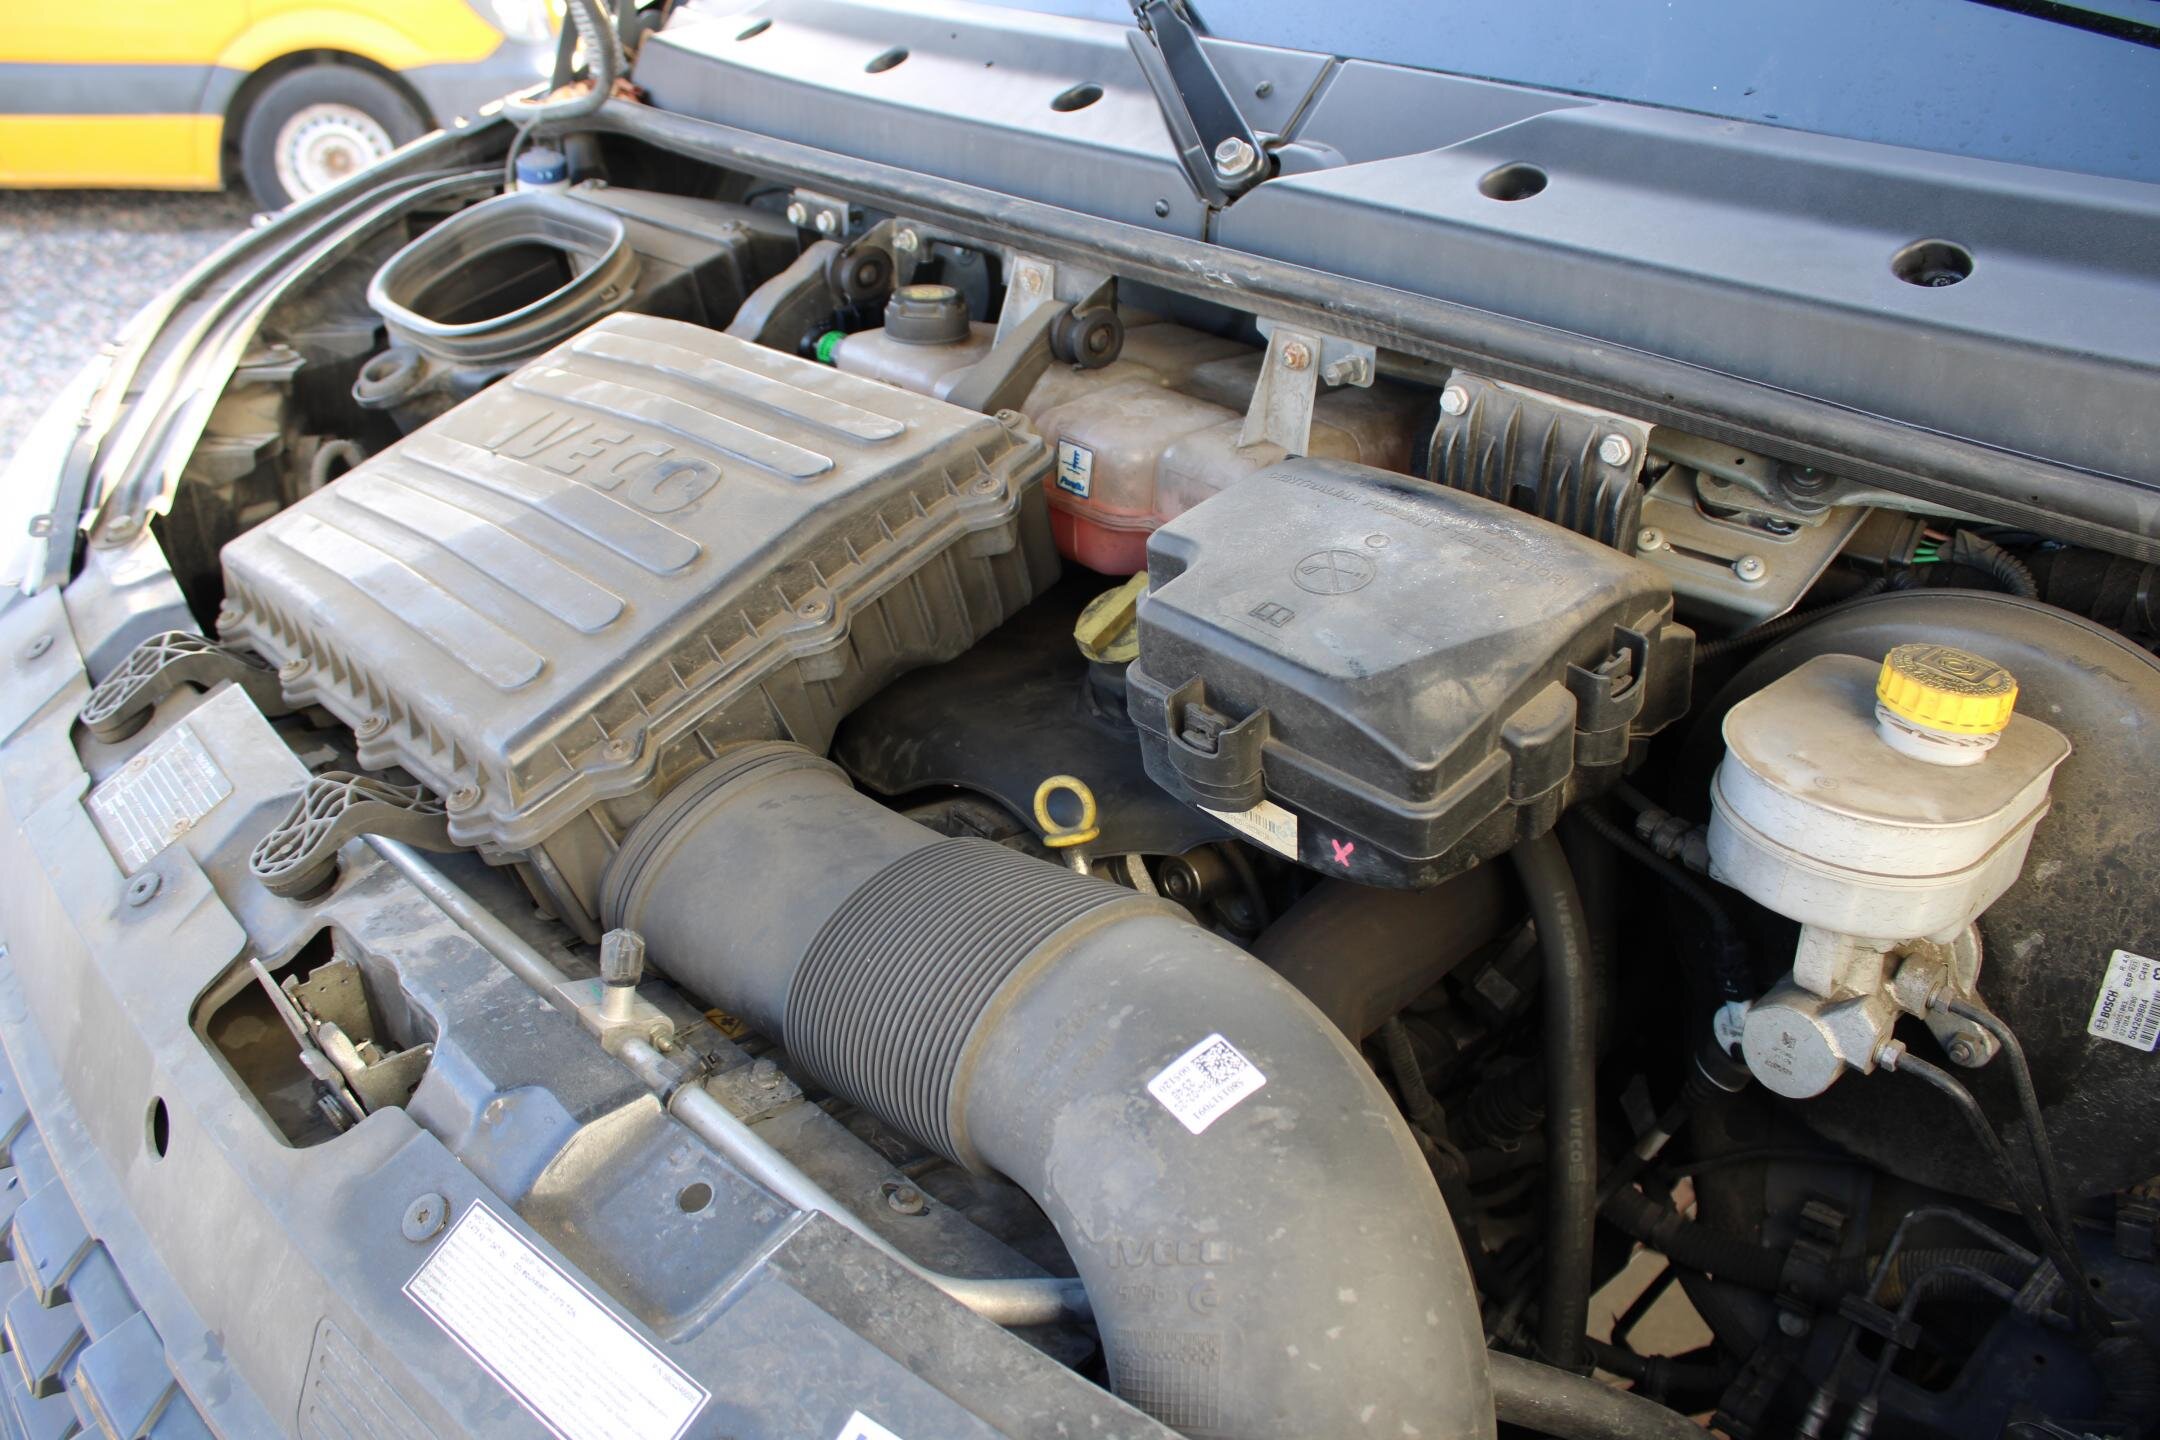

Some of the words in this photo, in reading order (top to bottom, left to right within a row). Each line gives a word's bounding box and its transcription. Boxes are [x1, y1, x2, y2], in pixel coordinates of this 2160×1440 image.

[480, 411, 723, 514] IVECO
[2100, 990, 2119, 1019] BOSCH
[1569, 1108, 1583, 1163] IVECO
